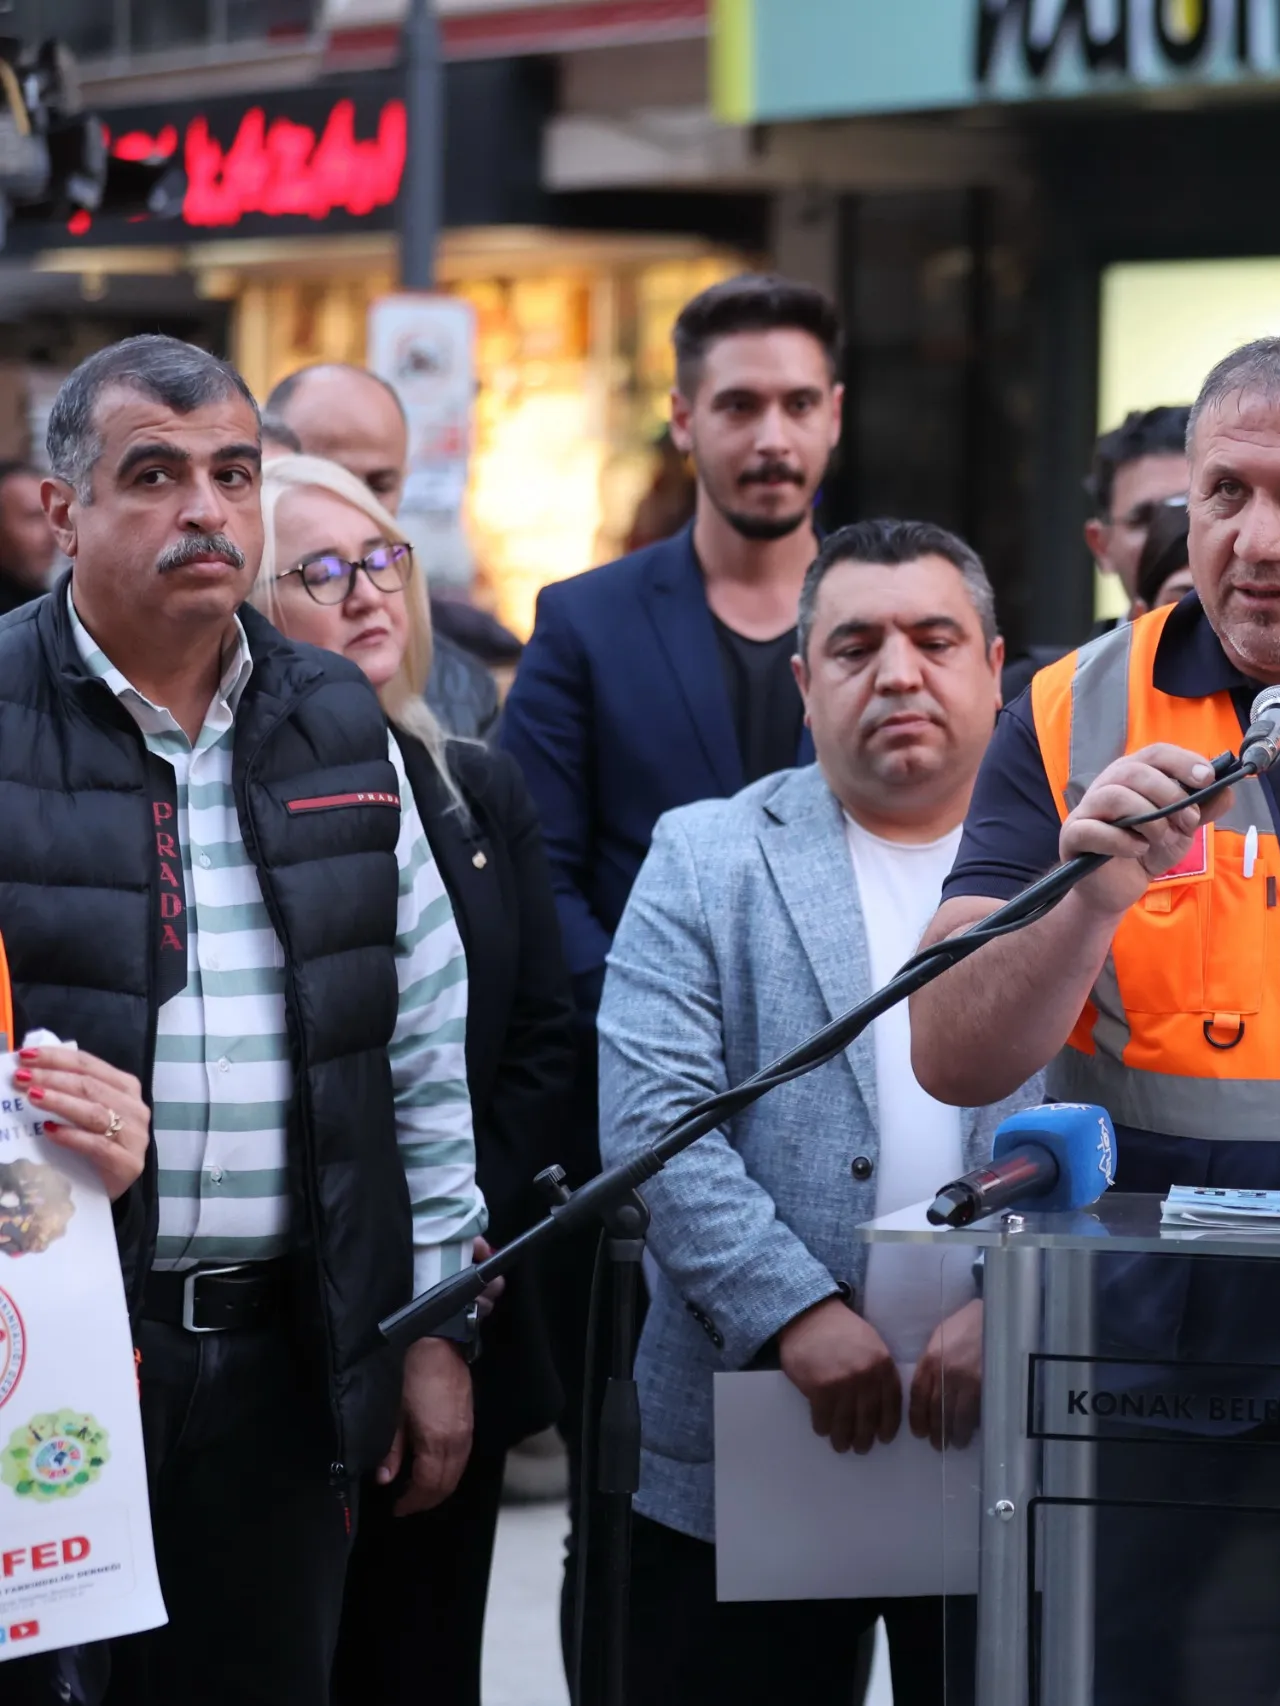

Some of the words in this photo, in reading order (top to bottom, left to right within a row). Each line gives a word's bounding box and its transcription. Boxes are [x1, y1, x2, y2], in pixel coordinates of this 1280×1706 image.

[357, 793, 399, 805] PRADA
[153, 801, 183, 950] PRADA
[1067, 1390, 1195, 1420] KONAK
